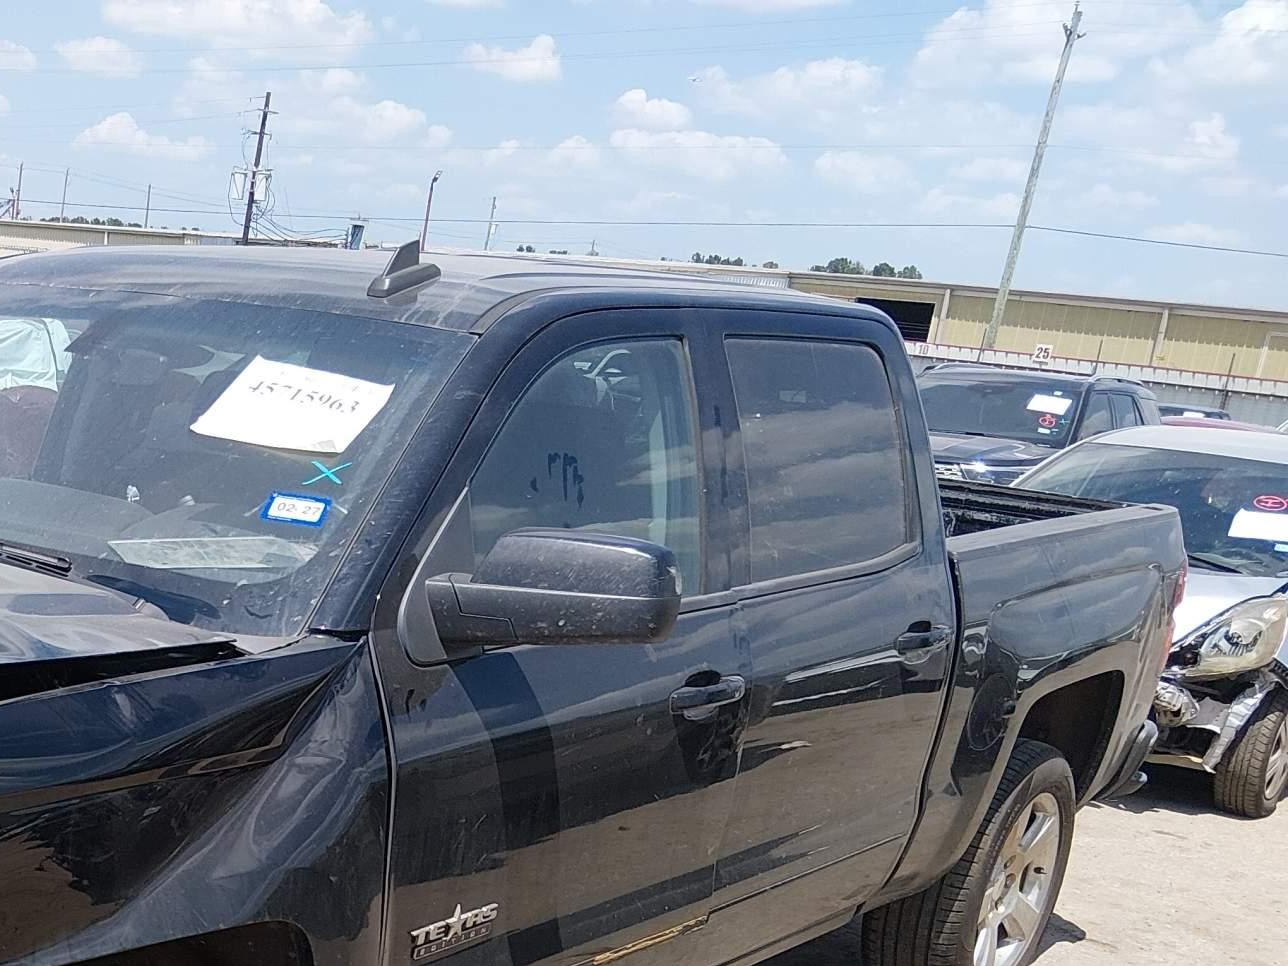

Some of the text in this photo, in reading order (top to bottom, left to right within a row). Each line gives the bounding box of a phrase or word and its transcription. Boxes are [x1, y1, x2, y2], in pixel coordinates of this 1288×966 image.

[1035, 346, 1050, 360] 25
[410, 903, 499, 946] TEXAS
[419, 926, 488, 957] EDITION
